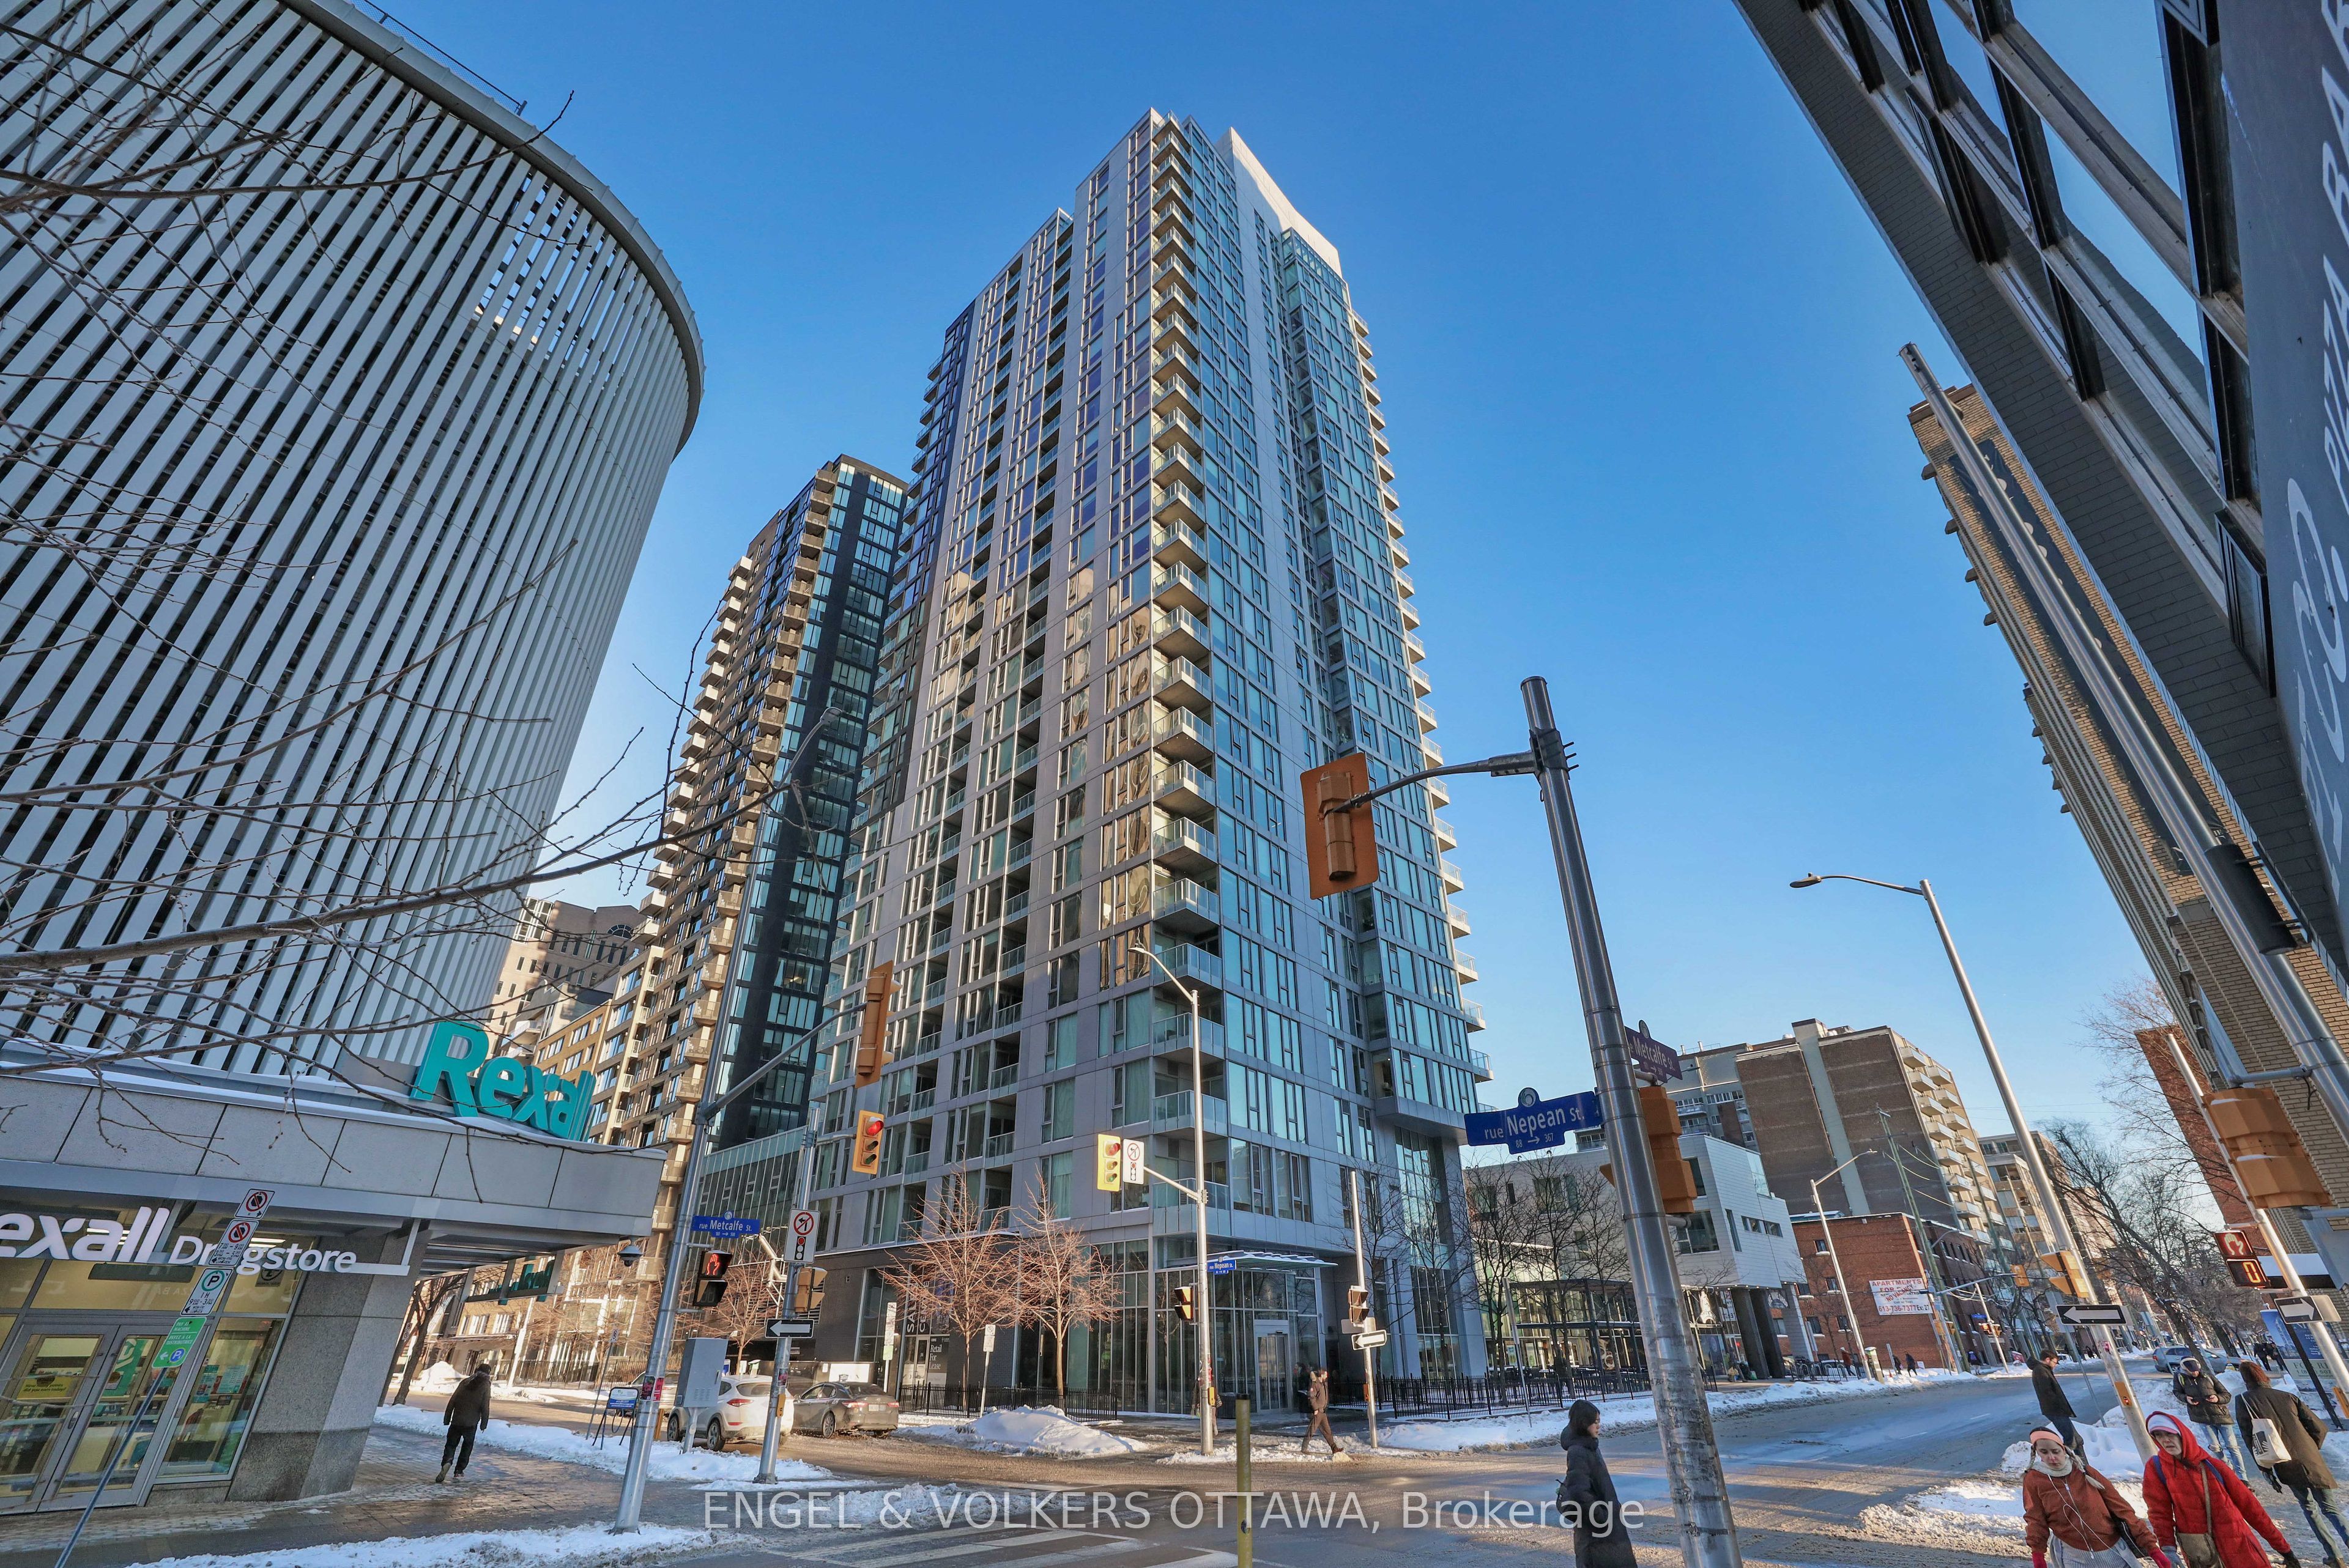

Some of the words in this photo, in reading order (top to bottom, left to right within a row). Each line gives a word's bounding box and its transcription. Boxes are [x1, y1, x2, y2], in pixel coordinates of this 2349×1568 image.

[1632, 1035, 1668, 1068] Metcalfe
[410, 1021, 596, 1142] Rexall
[1484, 1128, 1504, 1139] rue
[1506, 1108, 1566, 1137] Nepean
[1570, 1107, 1586, 1122] St.
[1515, 1139, 1523, 1148] 88
[1544, 1133, 1554, 1142] 367
[710, 1220, 743, 1231] Metcalfe
[168, 1235, 357, 1276] Drgstore
[2242, 1262, 2261, 1284] 0
[1894, 1284, 1914, 1298] VACANCY
[930, 1344, 942, 1353] Retail
